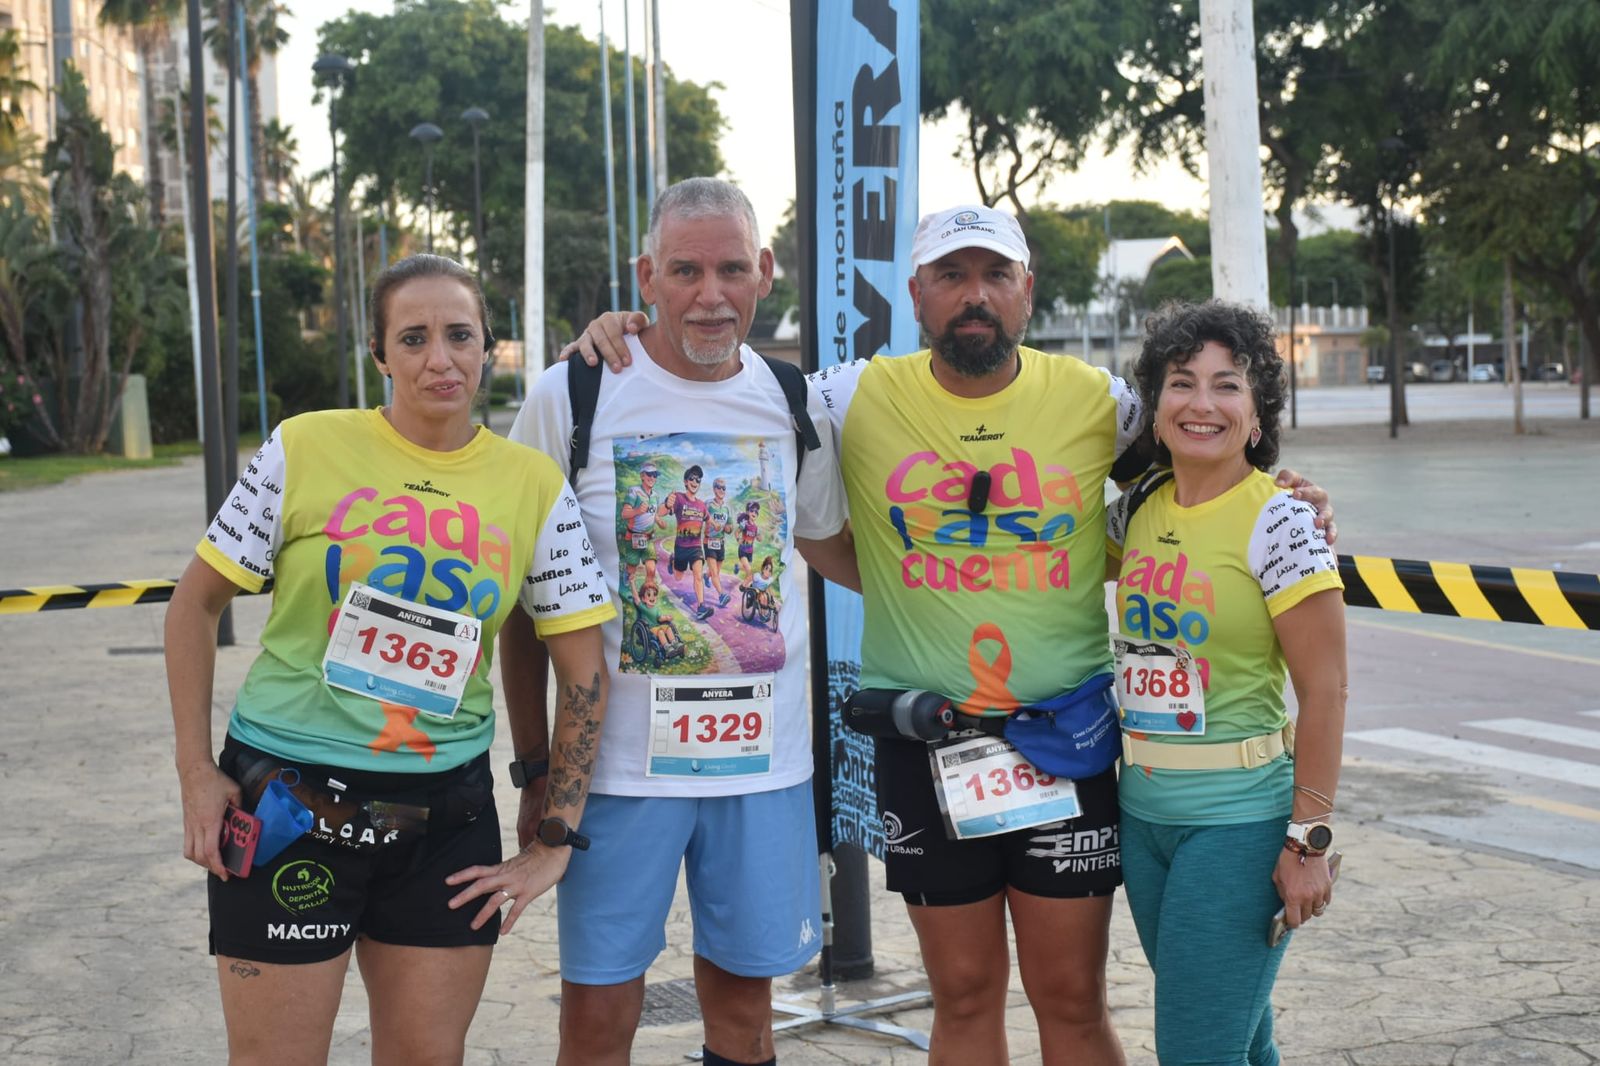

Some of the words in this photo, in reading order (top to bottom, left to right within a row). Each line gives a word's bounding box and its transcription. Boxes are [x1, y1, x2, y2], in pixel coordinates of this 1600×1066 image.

[832, 100, 846, 298] montaña
[833, 311, 848, 365] de
[959, 432, 1006, 443] TEAMERGY
[885, 446, 1083, 513] Cada
[403, 482, 452, 498] TEAMERGY
[321, 486, 512, 592] Cada
[525, 567, 573, 586] Ruffles
[1299, 566, 1316, 578] Toy
[397, 611, 433, 628] ANYERA
[357, 626, 459, 680] 1363
[1122, 666, 1191, 698] 1368
[701, 690, 733, 699] ANYERA
[672, 711, 762, 744] 1329
[890, 845, 924, 856] URBANO
[266, 923, 352, 941] MACUTY
